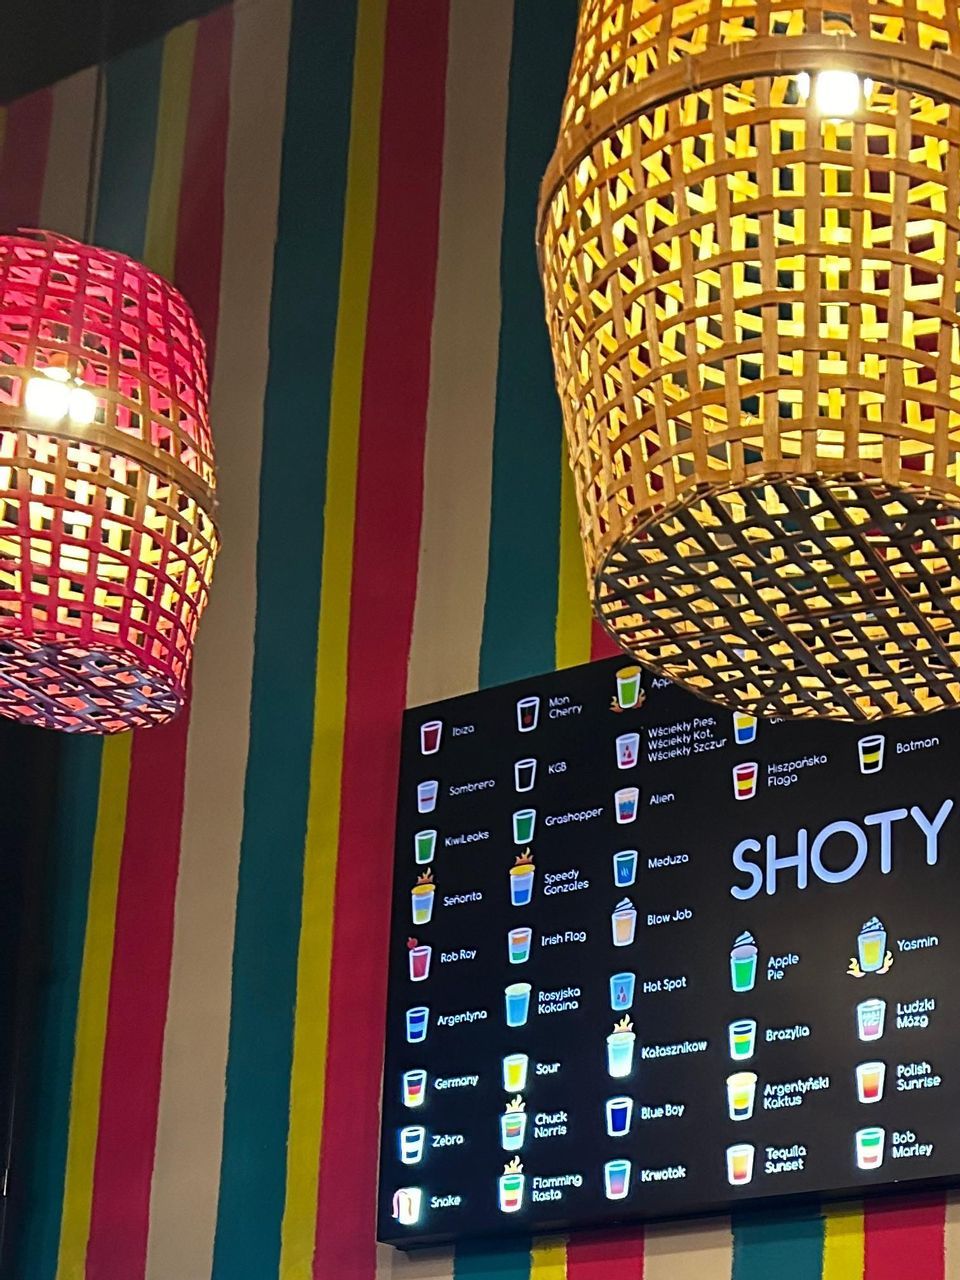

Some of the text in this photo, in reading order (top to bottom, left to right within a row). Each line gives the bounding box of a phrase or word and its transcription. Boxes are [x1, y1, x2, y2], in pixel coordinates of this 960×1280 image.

[548, 695, 570, 708] Mon
[549, 704, 583, 718] Cherry
[452, 724, 475, 736] Ibiza
[693, 738, 728, 752] Szczur
[896, 736, 940, 754] Batman
[548, 762, 567, 774] KGB
[449, 778, 495, 796] Sombrero
[767, 773, 798, 788] Flaga
[649, 792, 675, 805] Alien
[544, 806, 603, 827] Grashopper
[730, 799, 954, 900] SHOTY
[647, 853, 689, 869] Meduza
[543, 869, 580, 885] Speedy
[543, 879, 590, 896] Gonzales
[647, 909, 693, 926] Blow Job
[541, 931, 587, 946] Irish Flag
[896, 934, 939, 952] Yasmin
[440, 949, 477, 963] Rob Roy
[538, 987, 581, 1002] Rosyjska
[537, 1000, 579, 1014] Kokaina
[896, 999, 936, 1014] Ludzki
[896, 1013, 929, 1029] Mózg
[765, 1025, 810, 1043] Brazylia
[535, 1062, 561, 1075] Sour
[434, 1074, 479, 1090] Germany
[763, 1093, 803, 1110] Kaktus
[534, 1111, 568, 1125] Chuck
[641, 1104, 685, 1119] Blue Boy
[534, 1124, 567, 1138] Norris
[892, 1130, 916, 1144] Bob
[432, 1134, 464, 1147] Zebra
[764, 1145, 807, 1161] Tequila
[892, 1142, 933, 1159] Marley
[764, 1158, 804, 1174] Sunset
[430, 1195, 461, 1208] Snake
